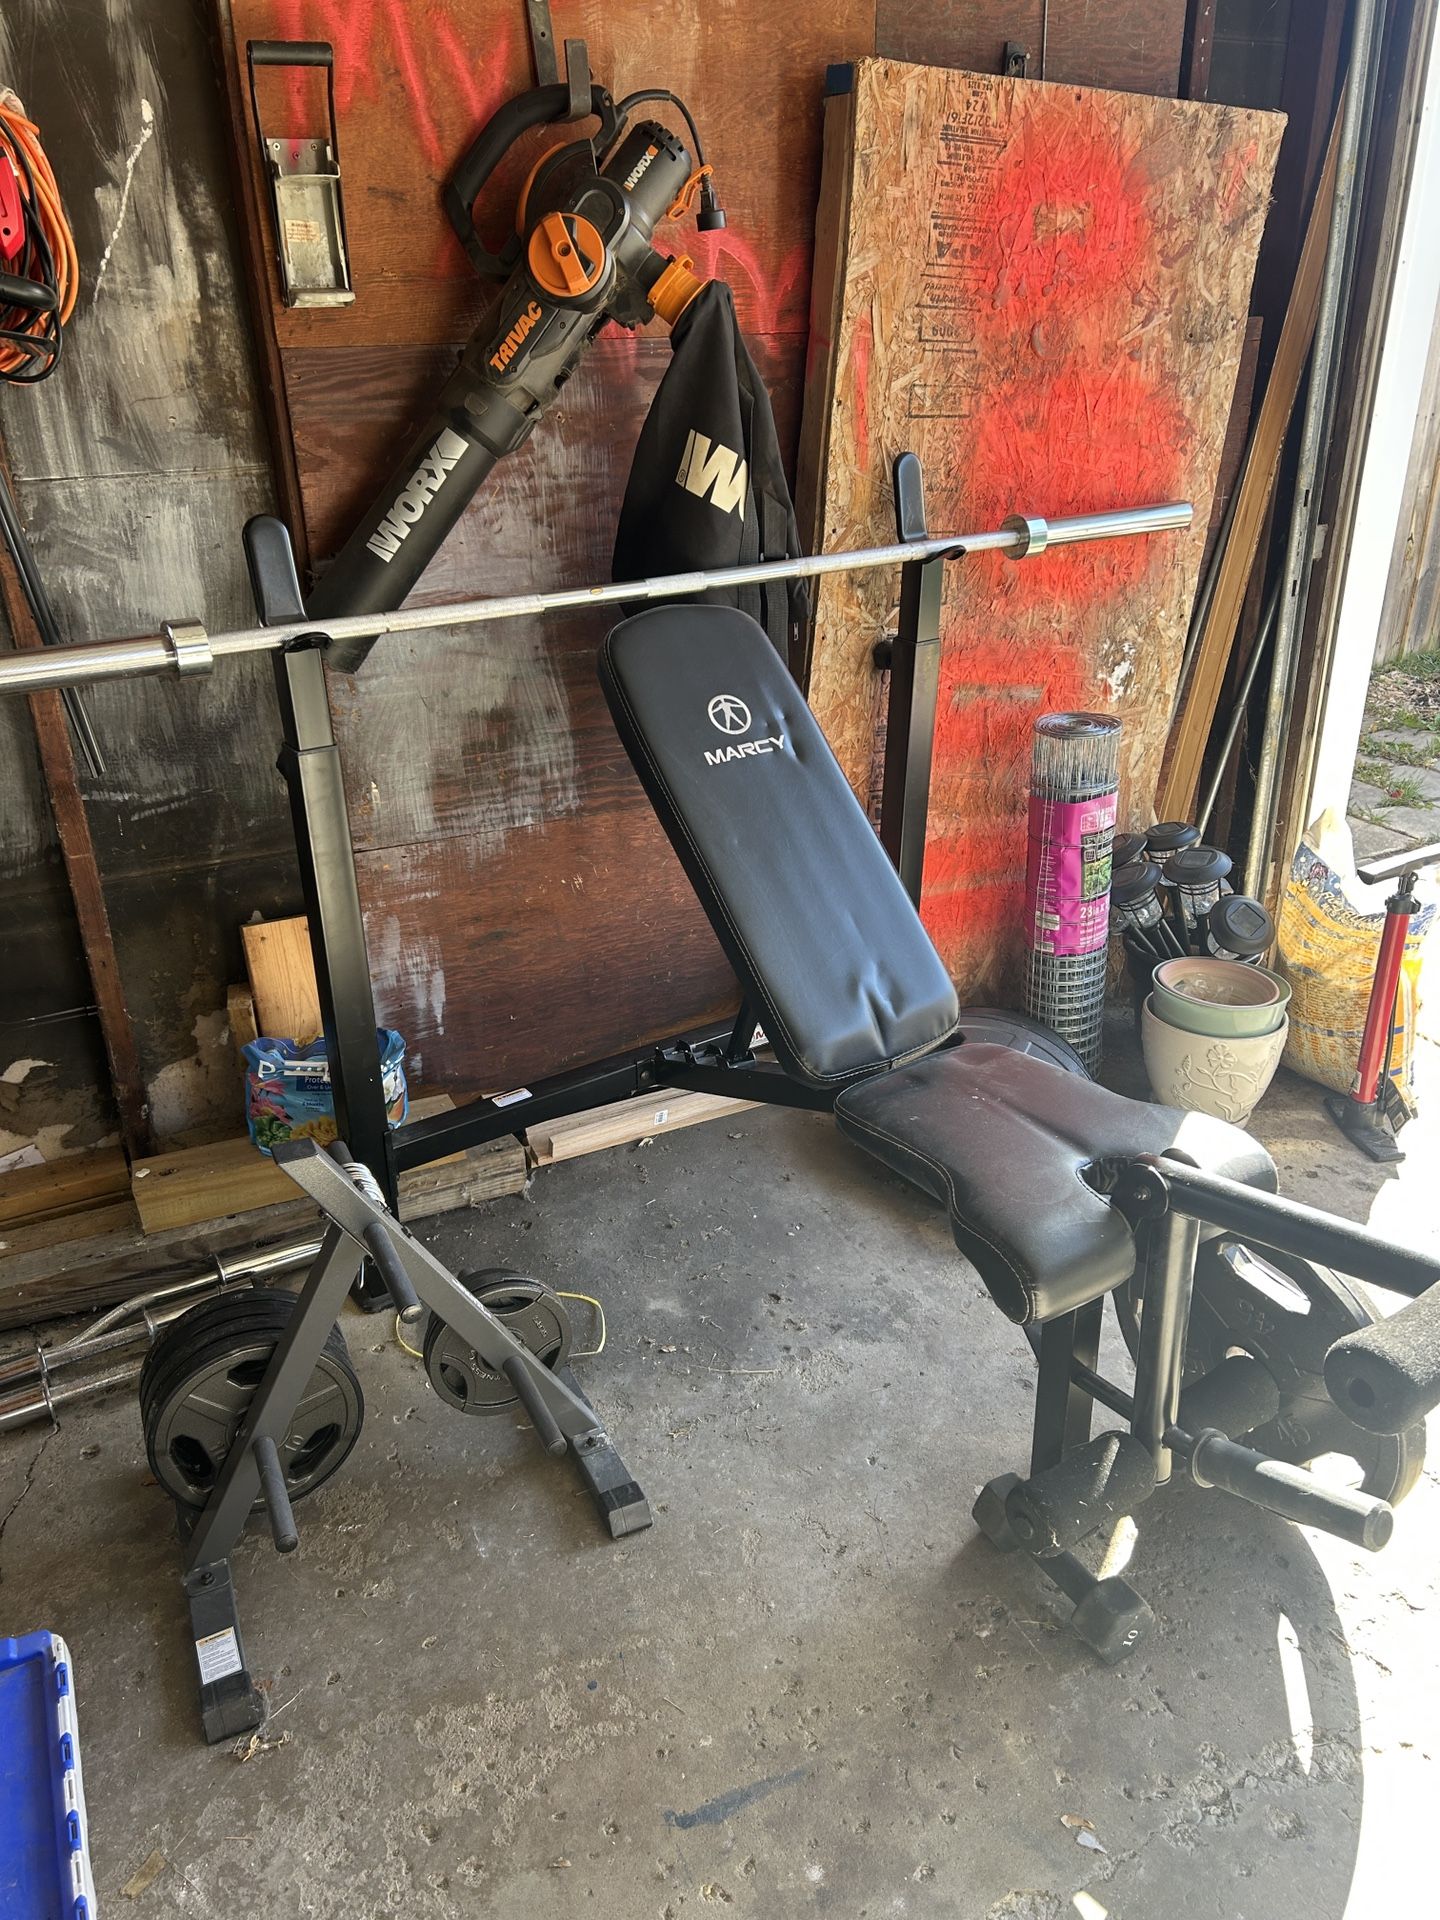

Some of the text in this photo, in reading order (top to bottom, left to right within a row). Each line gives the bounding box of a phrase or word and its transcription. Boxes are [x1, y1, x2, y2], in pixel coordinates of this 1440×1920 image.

[624, 147, 656, 190] WORX
[489, 301, 543, 372] TRIVAC
[366, 436, 460, 563] WORX
[703, 734, 785, 766] MARCY
[1122, 1630, 1139, 1646] 10
